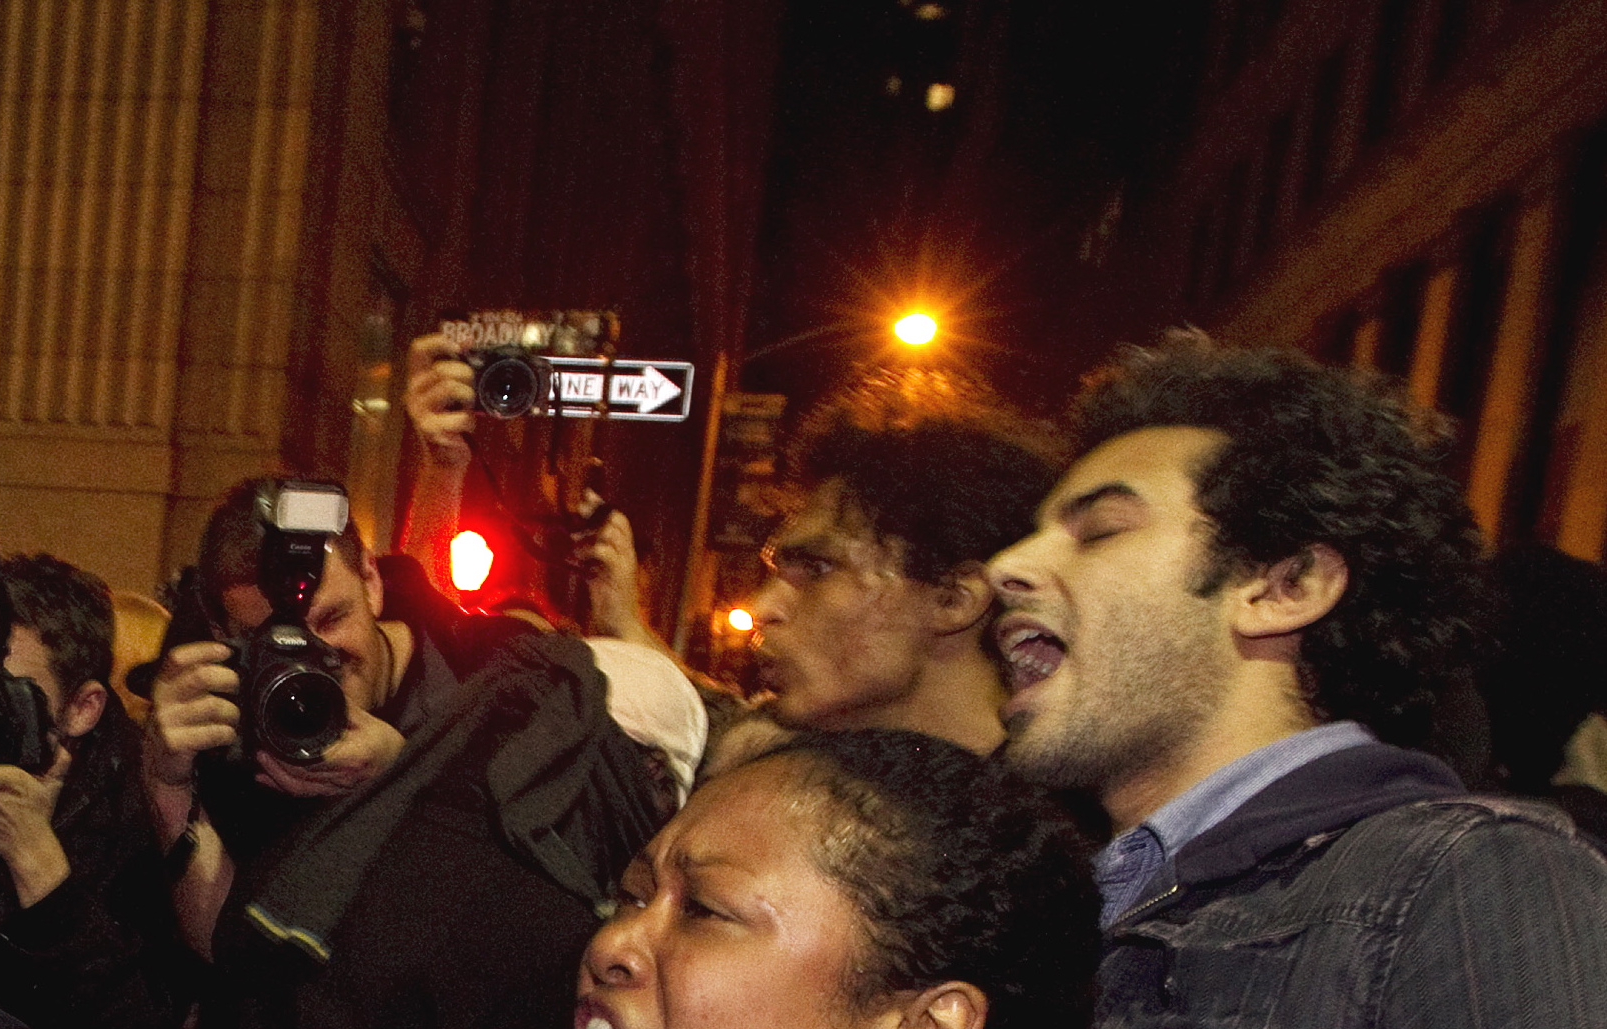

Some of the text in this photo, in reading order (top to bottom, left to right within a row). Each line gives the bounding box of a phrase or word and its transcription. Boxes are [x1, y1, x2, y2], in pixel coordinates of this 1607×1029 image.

[443, 321, 556, 347] BROADWY
[552, 376, 665, 398] NE WAY
